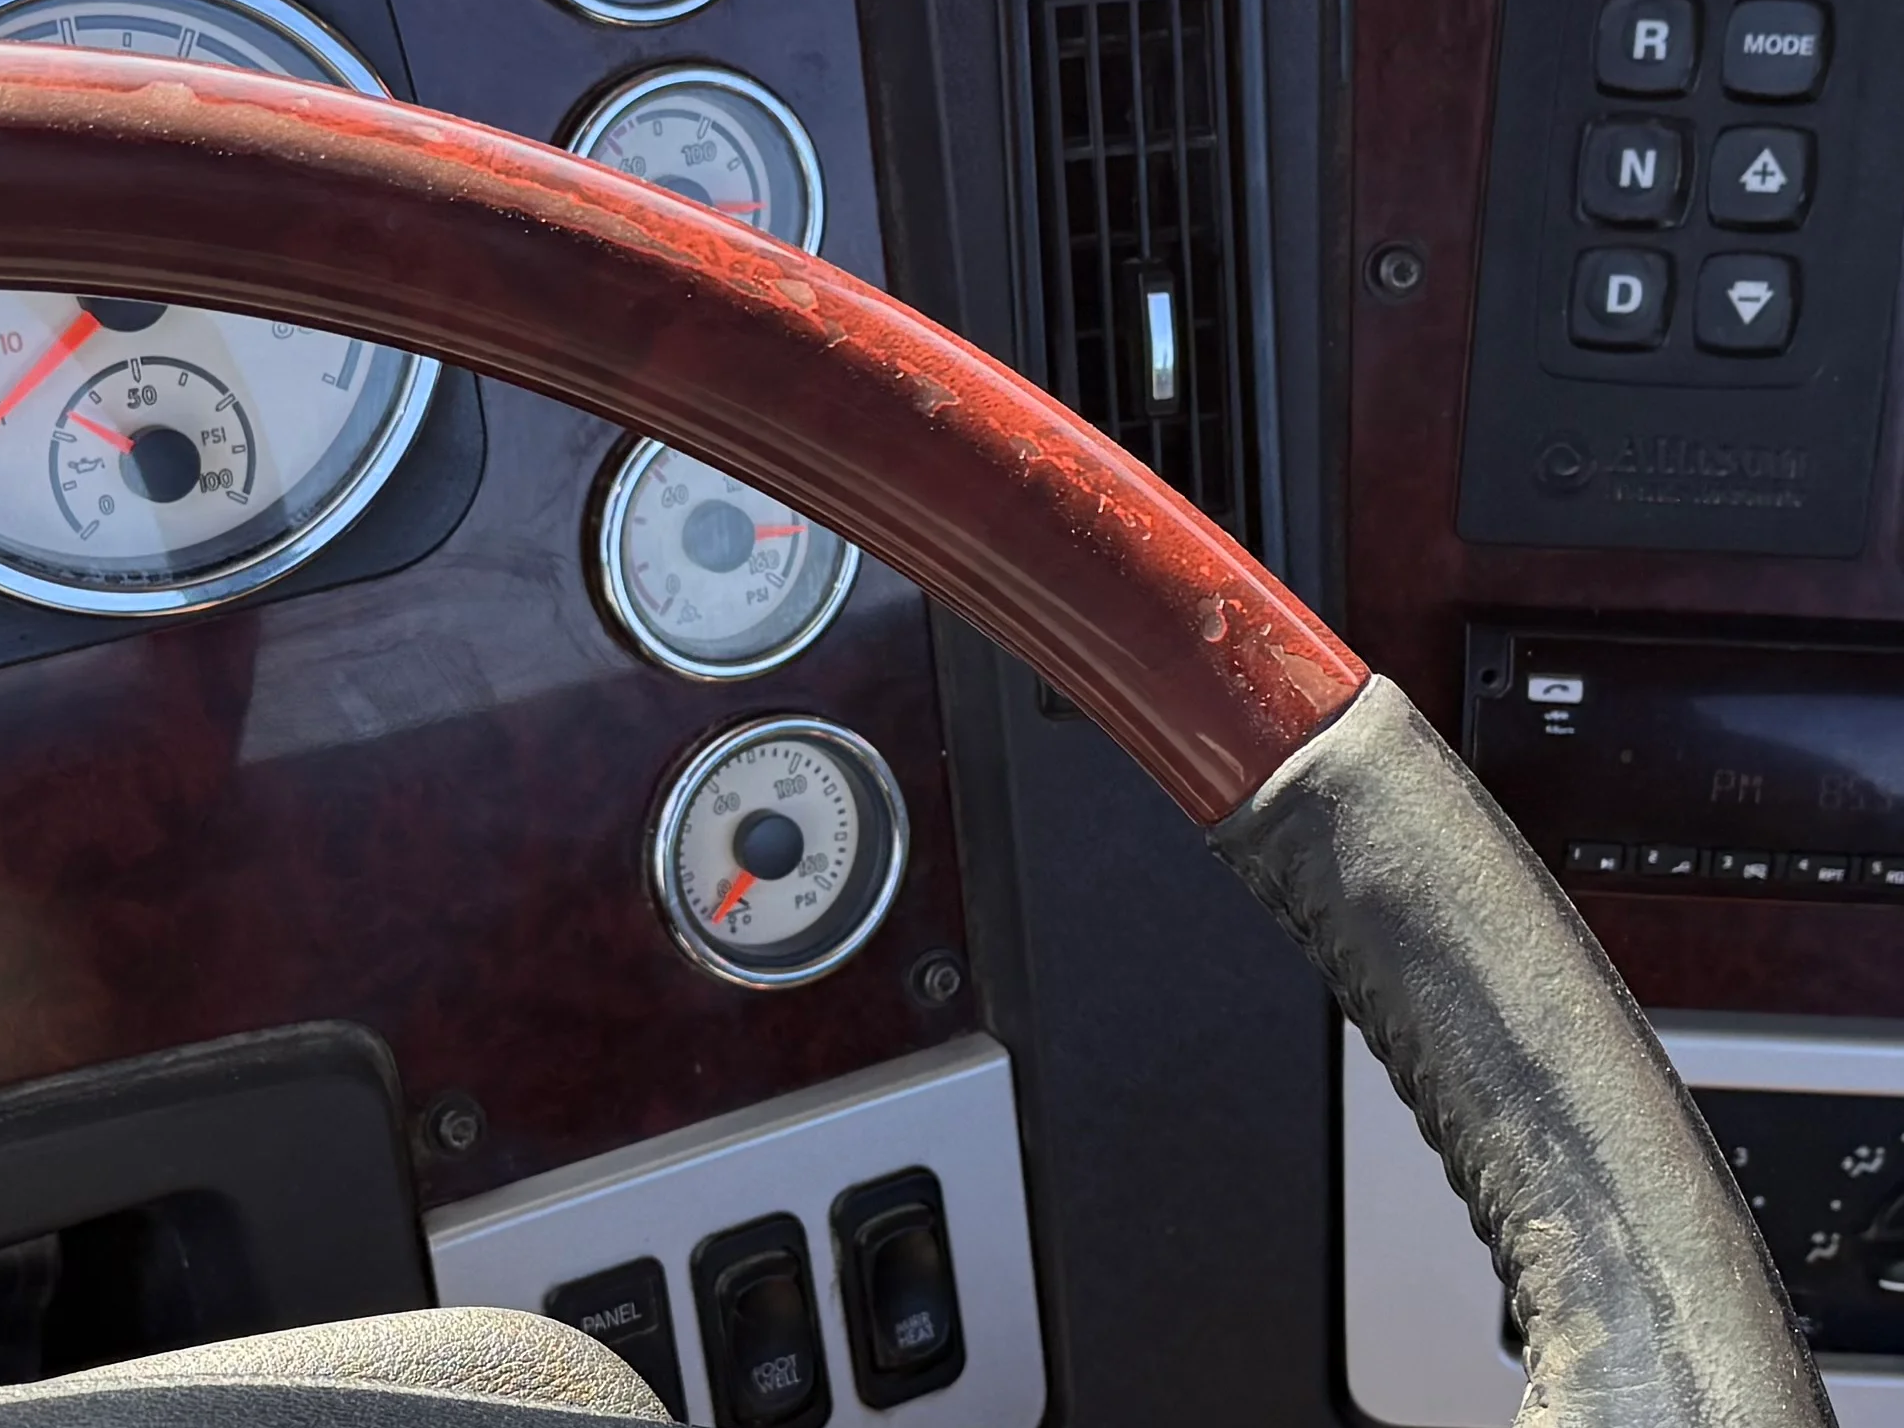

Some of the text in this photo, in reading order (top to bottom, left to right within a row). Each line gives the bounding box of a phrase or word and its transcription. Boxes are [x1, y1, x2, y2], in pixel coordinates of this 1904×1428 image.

[1631, 18, 1670, 62] R
[1743, 33, 1817, 58] MODE
[681, 140, 717, 167] 100
[1618, 147, 1658, 190] N
[1605, 274, 1643, 315] D
[125, 384, 158, 410] 50
[200, 426, 228, 448] PSI
[198, 468, 234, 494] 100
[97, 493, 116, 516] 0
[661, 483, 690, 509] 60
[665, 574, 681, 595] 0
[745, 586, 769, 606] PSI
[773, 775, 808, 801] 100
[712, 791, 742, 816] 60
[794, 890, 819, 910] PSI
[1734, 1146, 1750, 1168] 3
[582, 1301, 643, 1333] PANEL
[897, 1323, 936, 1349] HEAT
[751, 1353, 799, 1382] FOOT
[757, 1369, 801, 1395] WELL
